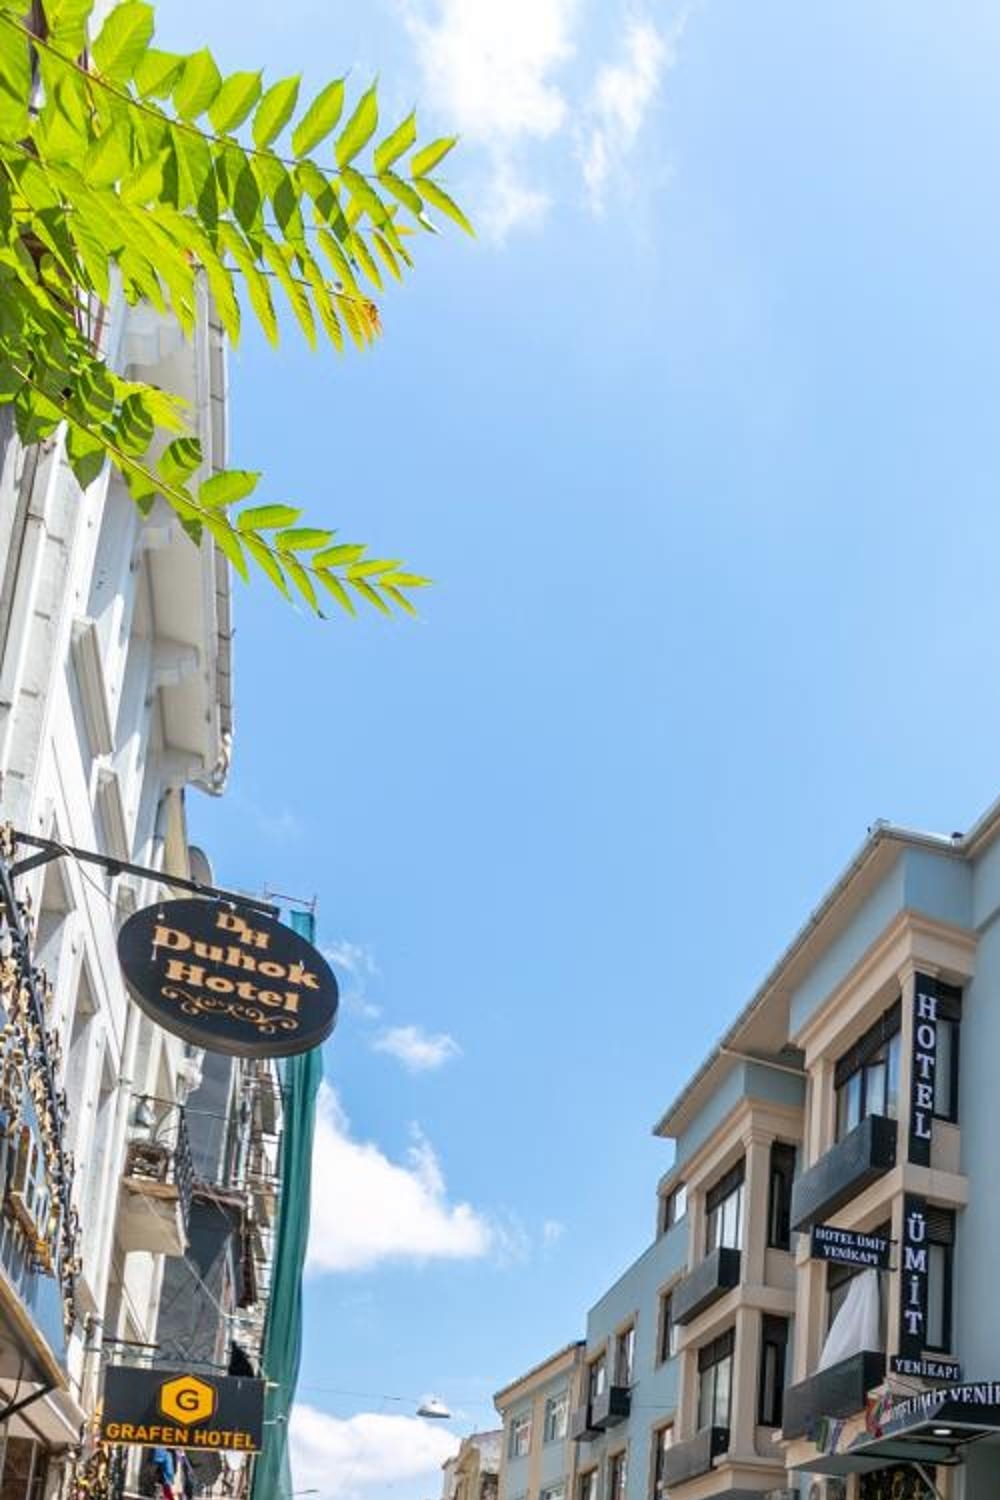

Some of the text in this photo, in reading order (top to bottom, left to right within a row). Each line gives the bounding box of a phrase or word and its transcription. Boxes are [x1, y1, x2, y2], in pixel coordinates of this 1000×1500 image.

[152, 925, 320, 989] Duhok
[165, 959, 299, 1013] Hotel
[914, 993, 937, 1140] HOTEL
[815, 1227, 855, 1245] HOTEL
[904, 1212, 926, 1335] ÜMİT
[895, 1358, 959, 1379] YENİKAPI
[175, 1388, 200, 1411] G
[106, 1423, 256, 1449] GRAFEN HOTEL
